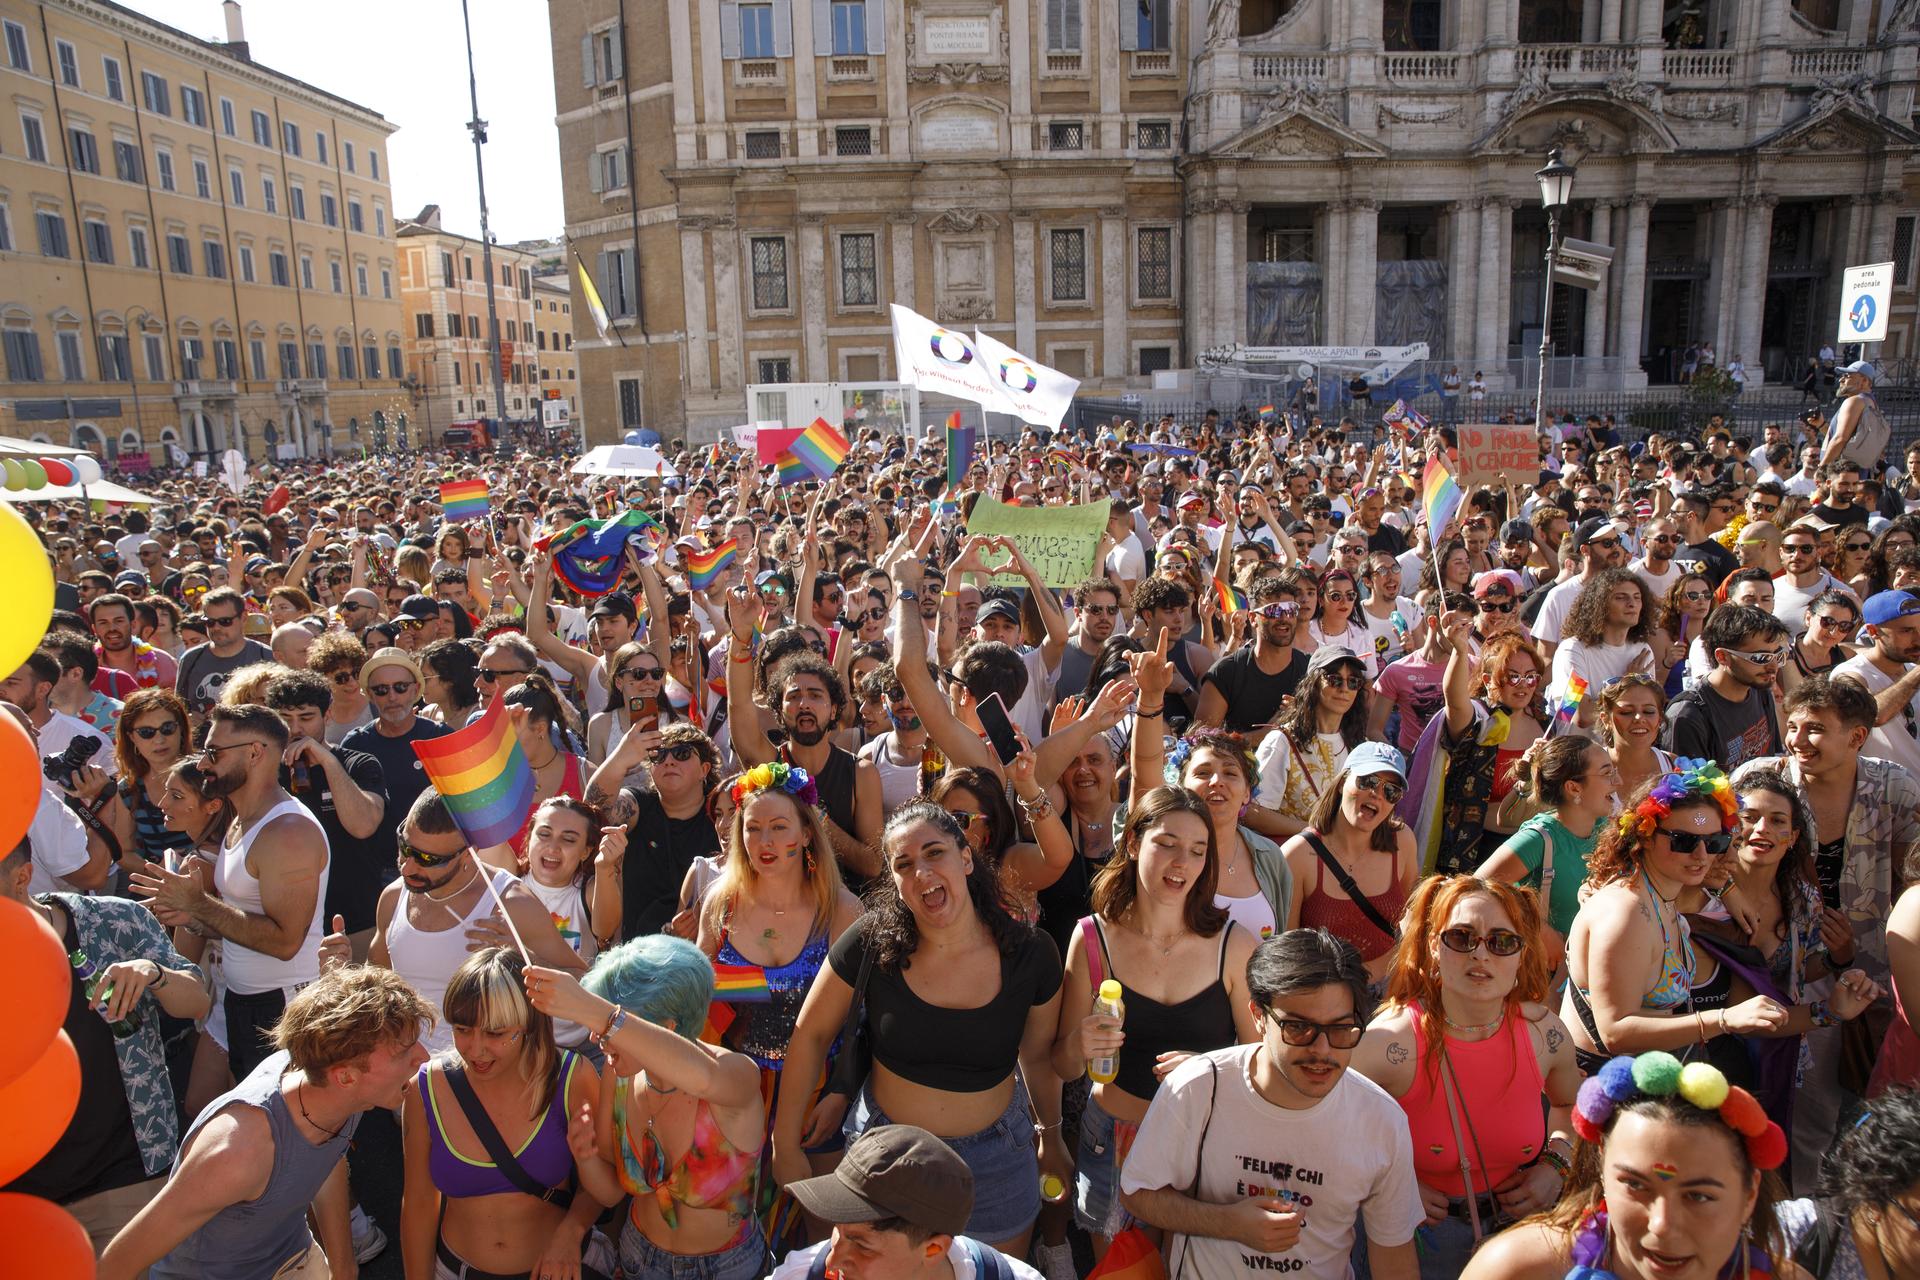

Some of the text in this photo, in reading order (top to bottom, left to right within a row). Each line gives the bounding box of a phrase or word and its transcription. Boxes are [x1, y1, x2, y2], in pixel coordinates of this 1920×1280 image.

[1853, 280, 1881, 290] pedonale
[1459, 428, 1483, 451] NO
[1295, 1168, 1324, 1186] CHI
[1236, 1179, 1245, 1196] È
